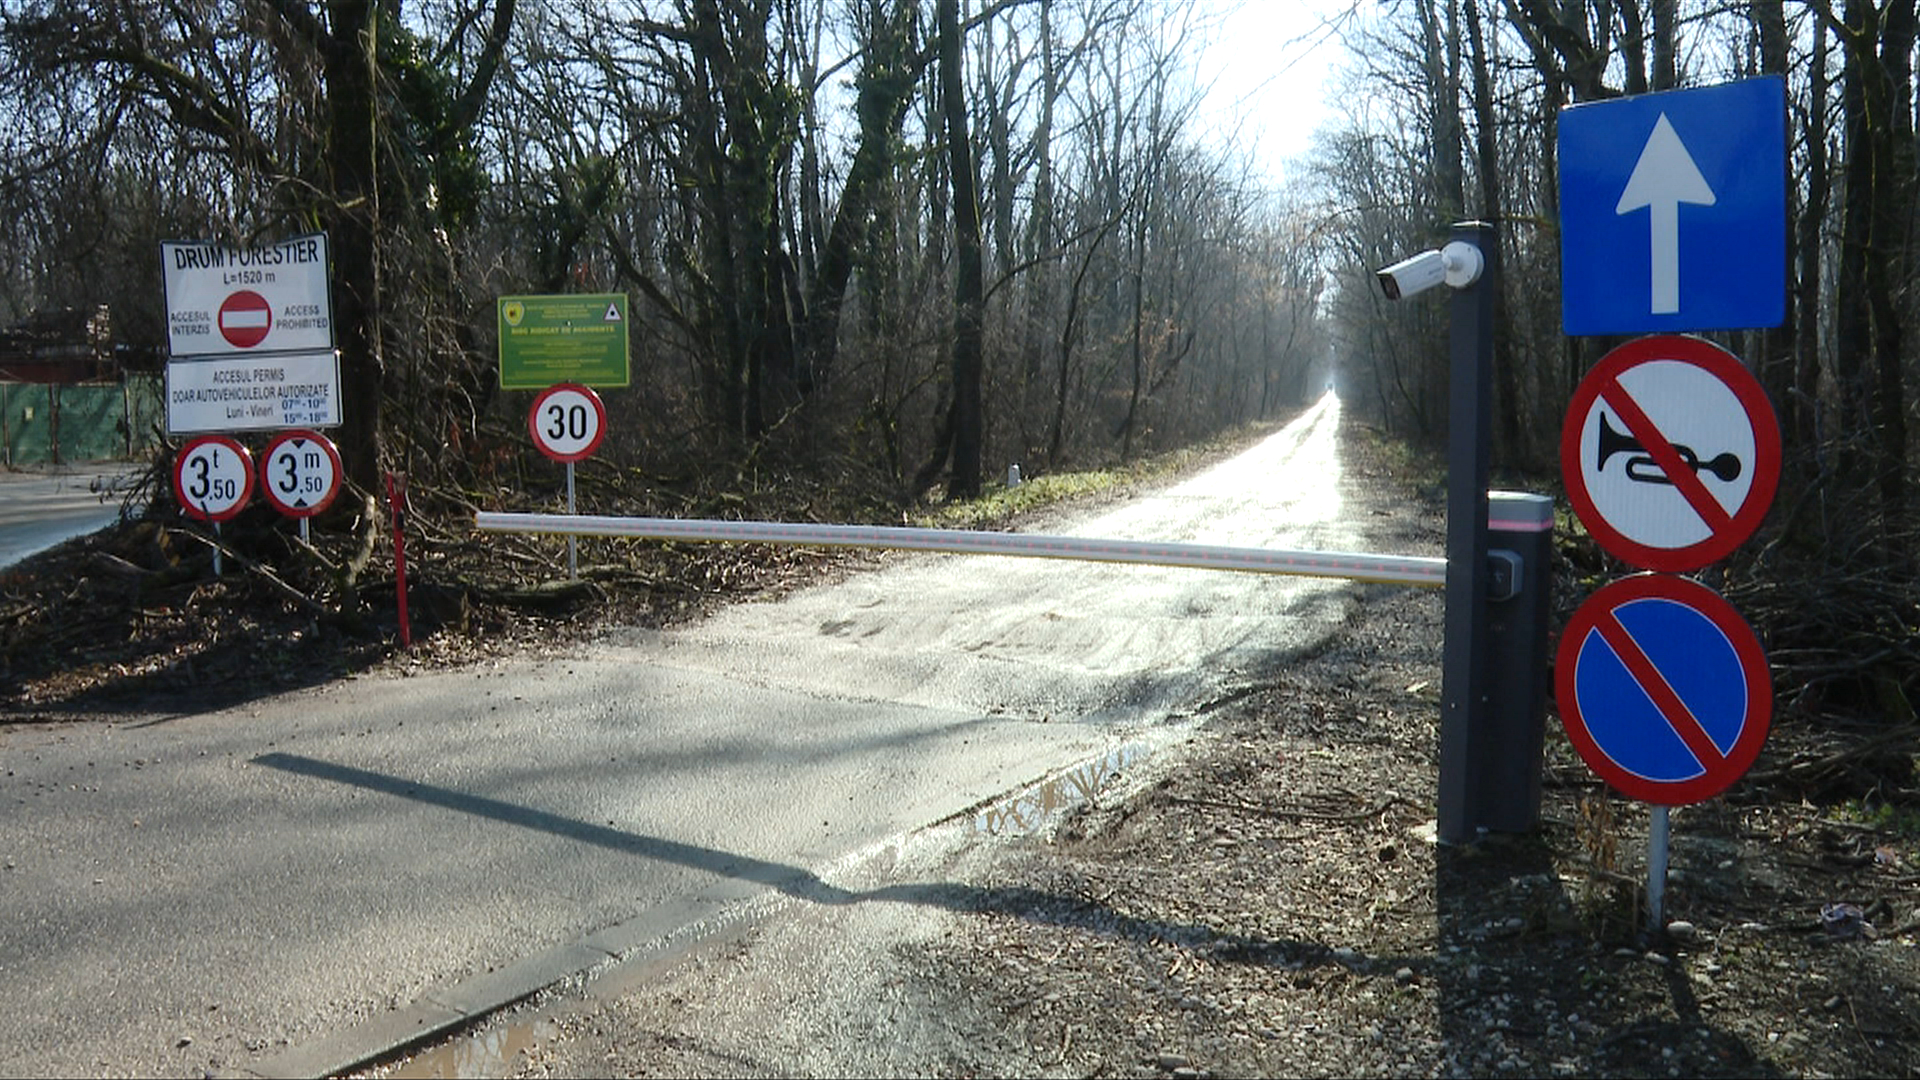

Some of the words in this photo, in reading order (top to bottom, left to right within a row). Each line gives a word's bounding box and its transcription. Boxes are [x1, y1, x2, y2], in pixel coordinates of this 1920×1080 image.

[174, 246, 224, 270] DRUM
[229, 240, 319, 267] FORESTIER
[223, 271, 262, 284] L=1520
[266, 273, 276, 283] m
[170, 311, 211, 322] ACCESUL
[284, 305, 320, 316] ACCESS
[172, 324, 211, 336] INTERZIS
[276, 318, 328, 330] PROHIBITED
[213, 371, 251, 383] ACCESUL
[253, 369, 285, 382] PERMIS
[173, 389, 196, 404] DOAR
[196, 386, 276, 402] AUTOVEHICULELOR
[277, 383, 329, 399] AUTORIZATE
[226, 407, 244, 419] Luni
[250, 405, 274, 418] Vineri
[547, 404, 587, 440] 30
